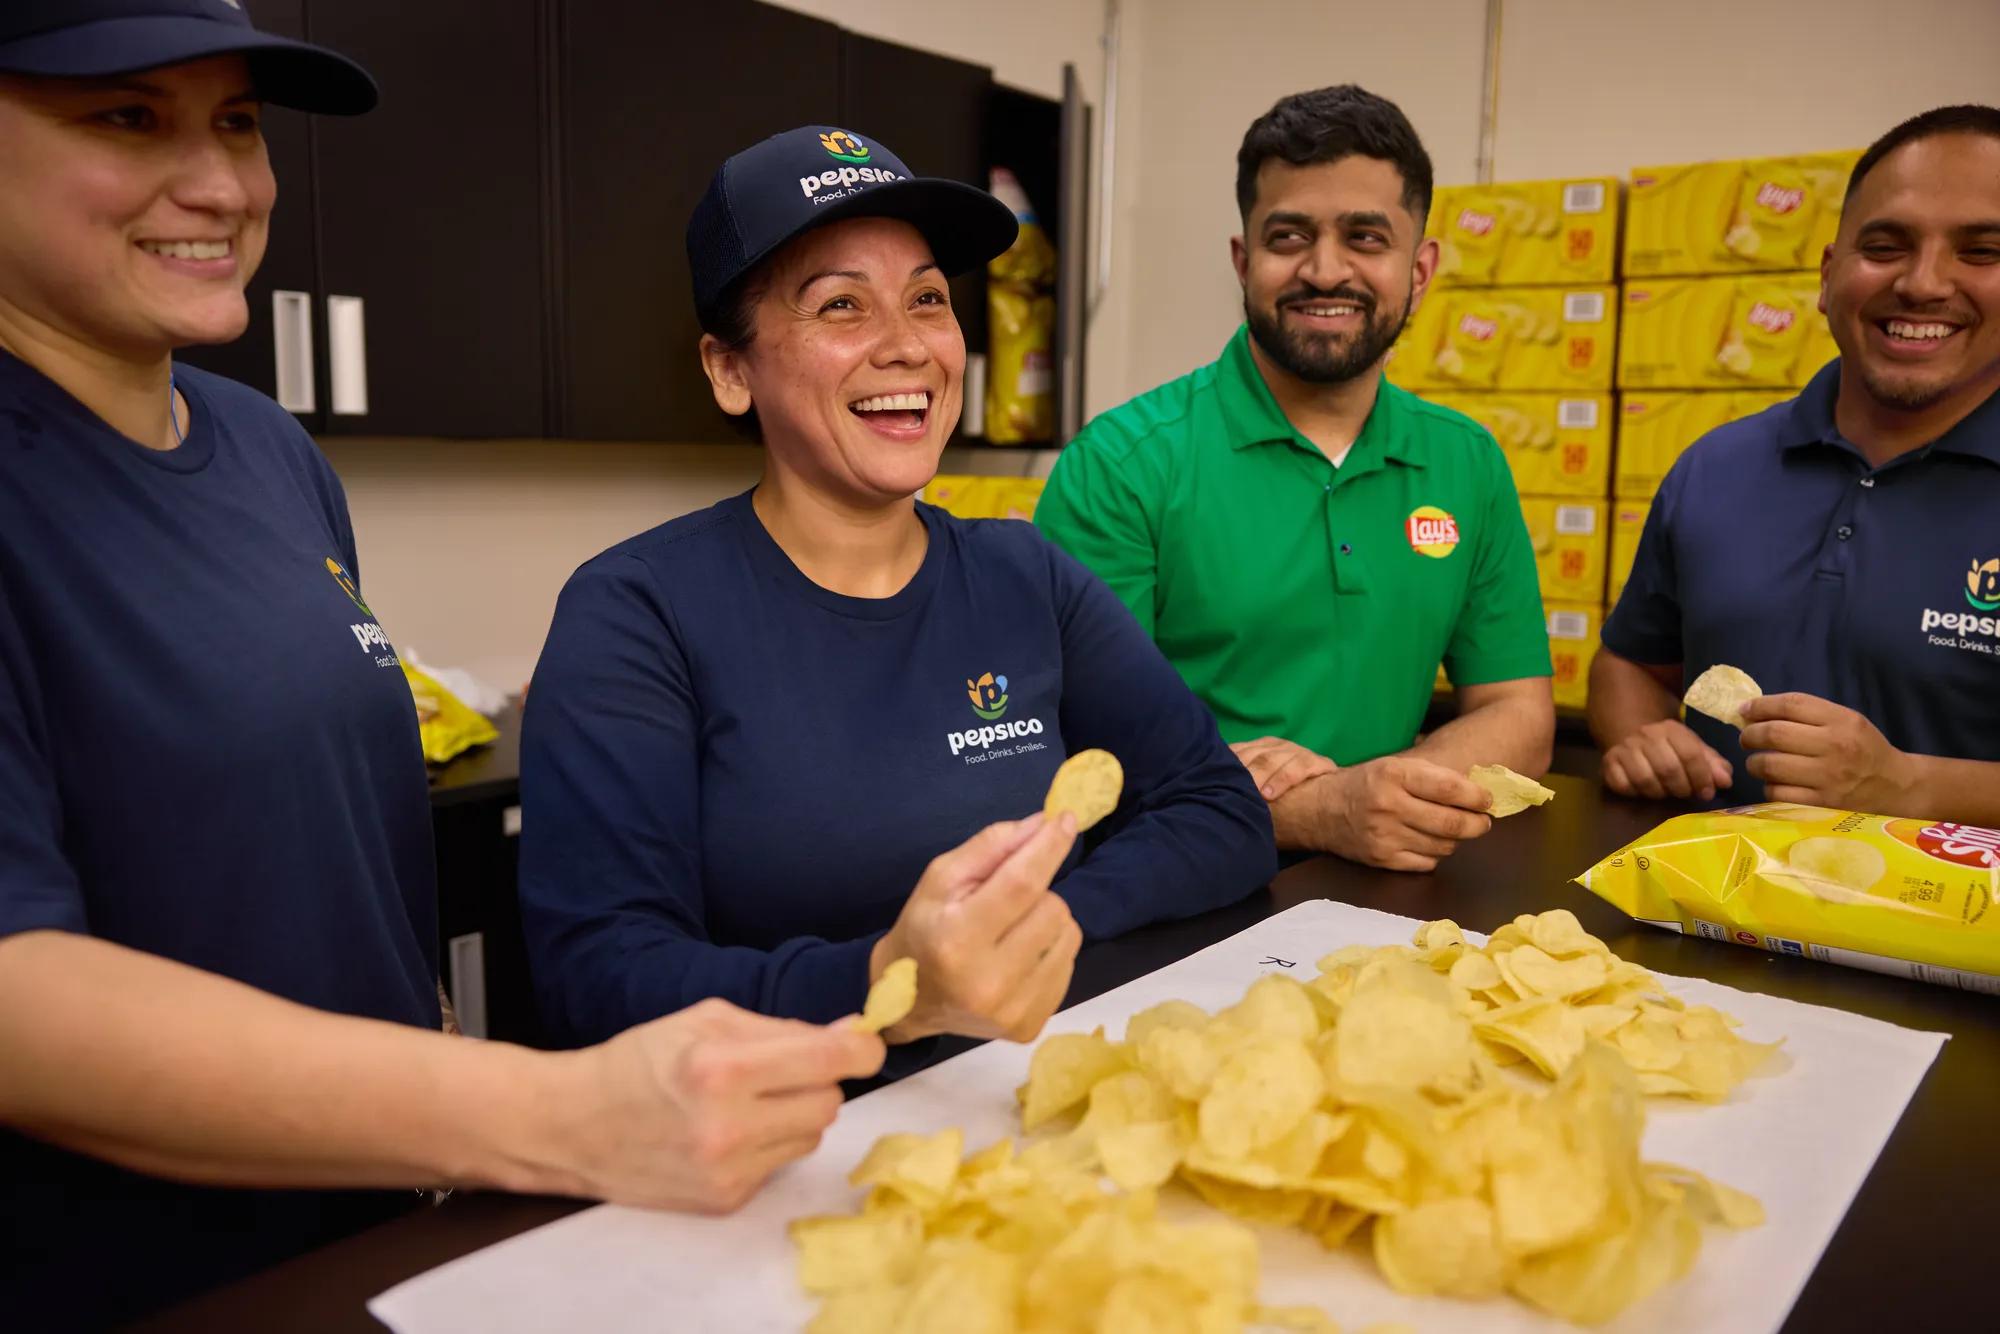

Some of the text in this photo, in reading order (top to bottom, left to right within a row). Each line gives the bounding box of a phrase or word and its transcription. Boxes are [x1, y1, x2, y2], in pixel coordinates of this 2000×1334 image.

[1928, 634, 1957, 648] Food.
[1959, 638, 1993, 654] Drinks.
[947, 718, 1043, 756] pepsico
[964, 742, 1048, 765] Food. Drinks. Smiles.
